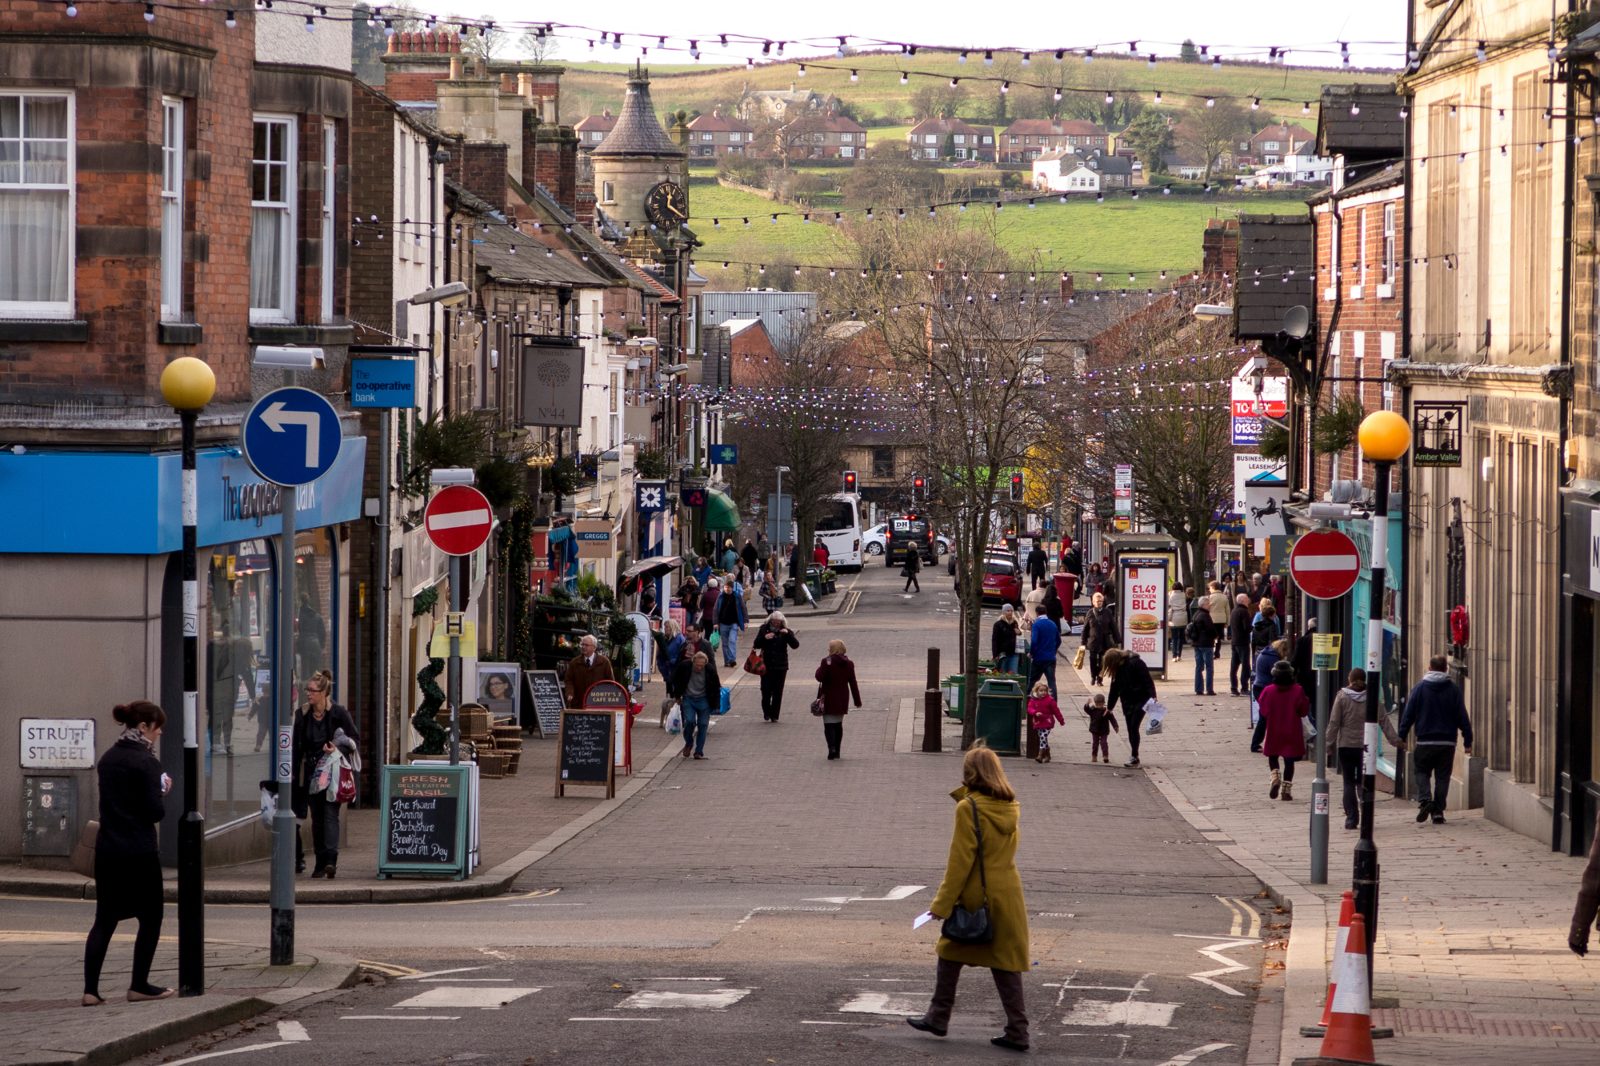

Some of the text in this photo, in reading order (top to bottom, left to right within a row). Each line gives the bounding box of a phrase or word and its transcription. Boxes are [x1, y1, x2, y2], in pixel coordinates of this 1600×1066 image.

[356, 369, 369, 379] The
[356, 381, 411, 391] co-operative
[355, 392, 375, 402] bank
[1235, 402, 1250, 413] TO
[1235, 423, 1262, 434] 01332
[1439, 453, 1461, 462] Valley
[1132, 585, 1157, 594] £1.49
[1132, 600, 1157, 610] BLC
[27, 727, 88, 741] STRUTT
[28, 746, 88, 760] STREET
[401, 775, 448, 784] FRESH
[403, 788, 448, 796] BASIL
[393, 799, 436, 810] The Award
[390, 843, 449, 861] Served All Day
